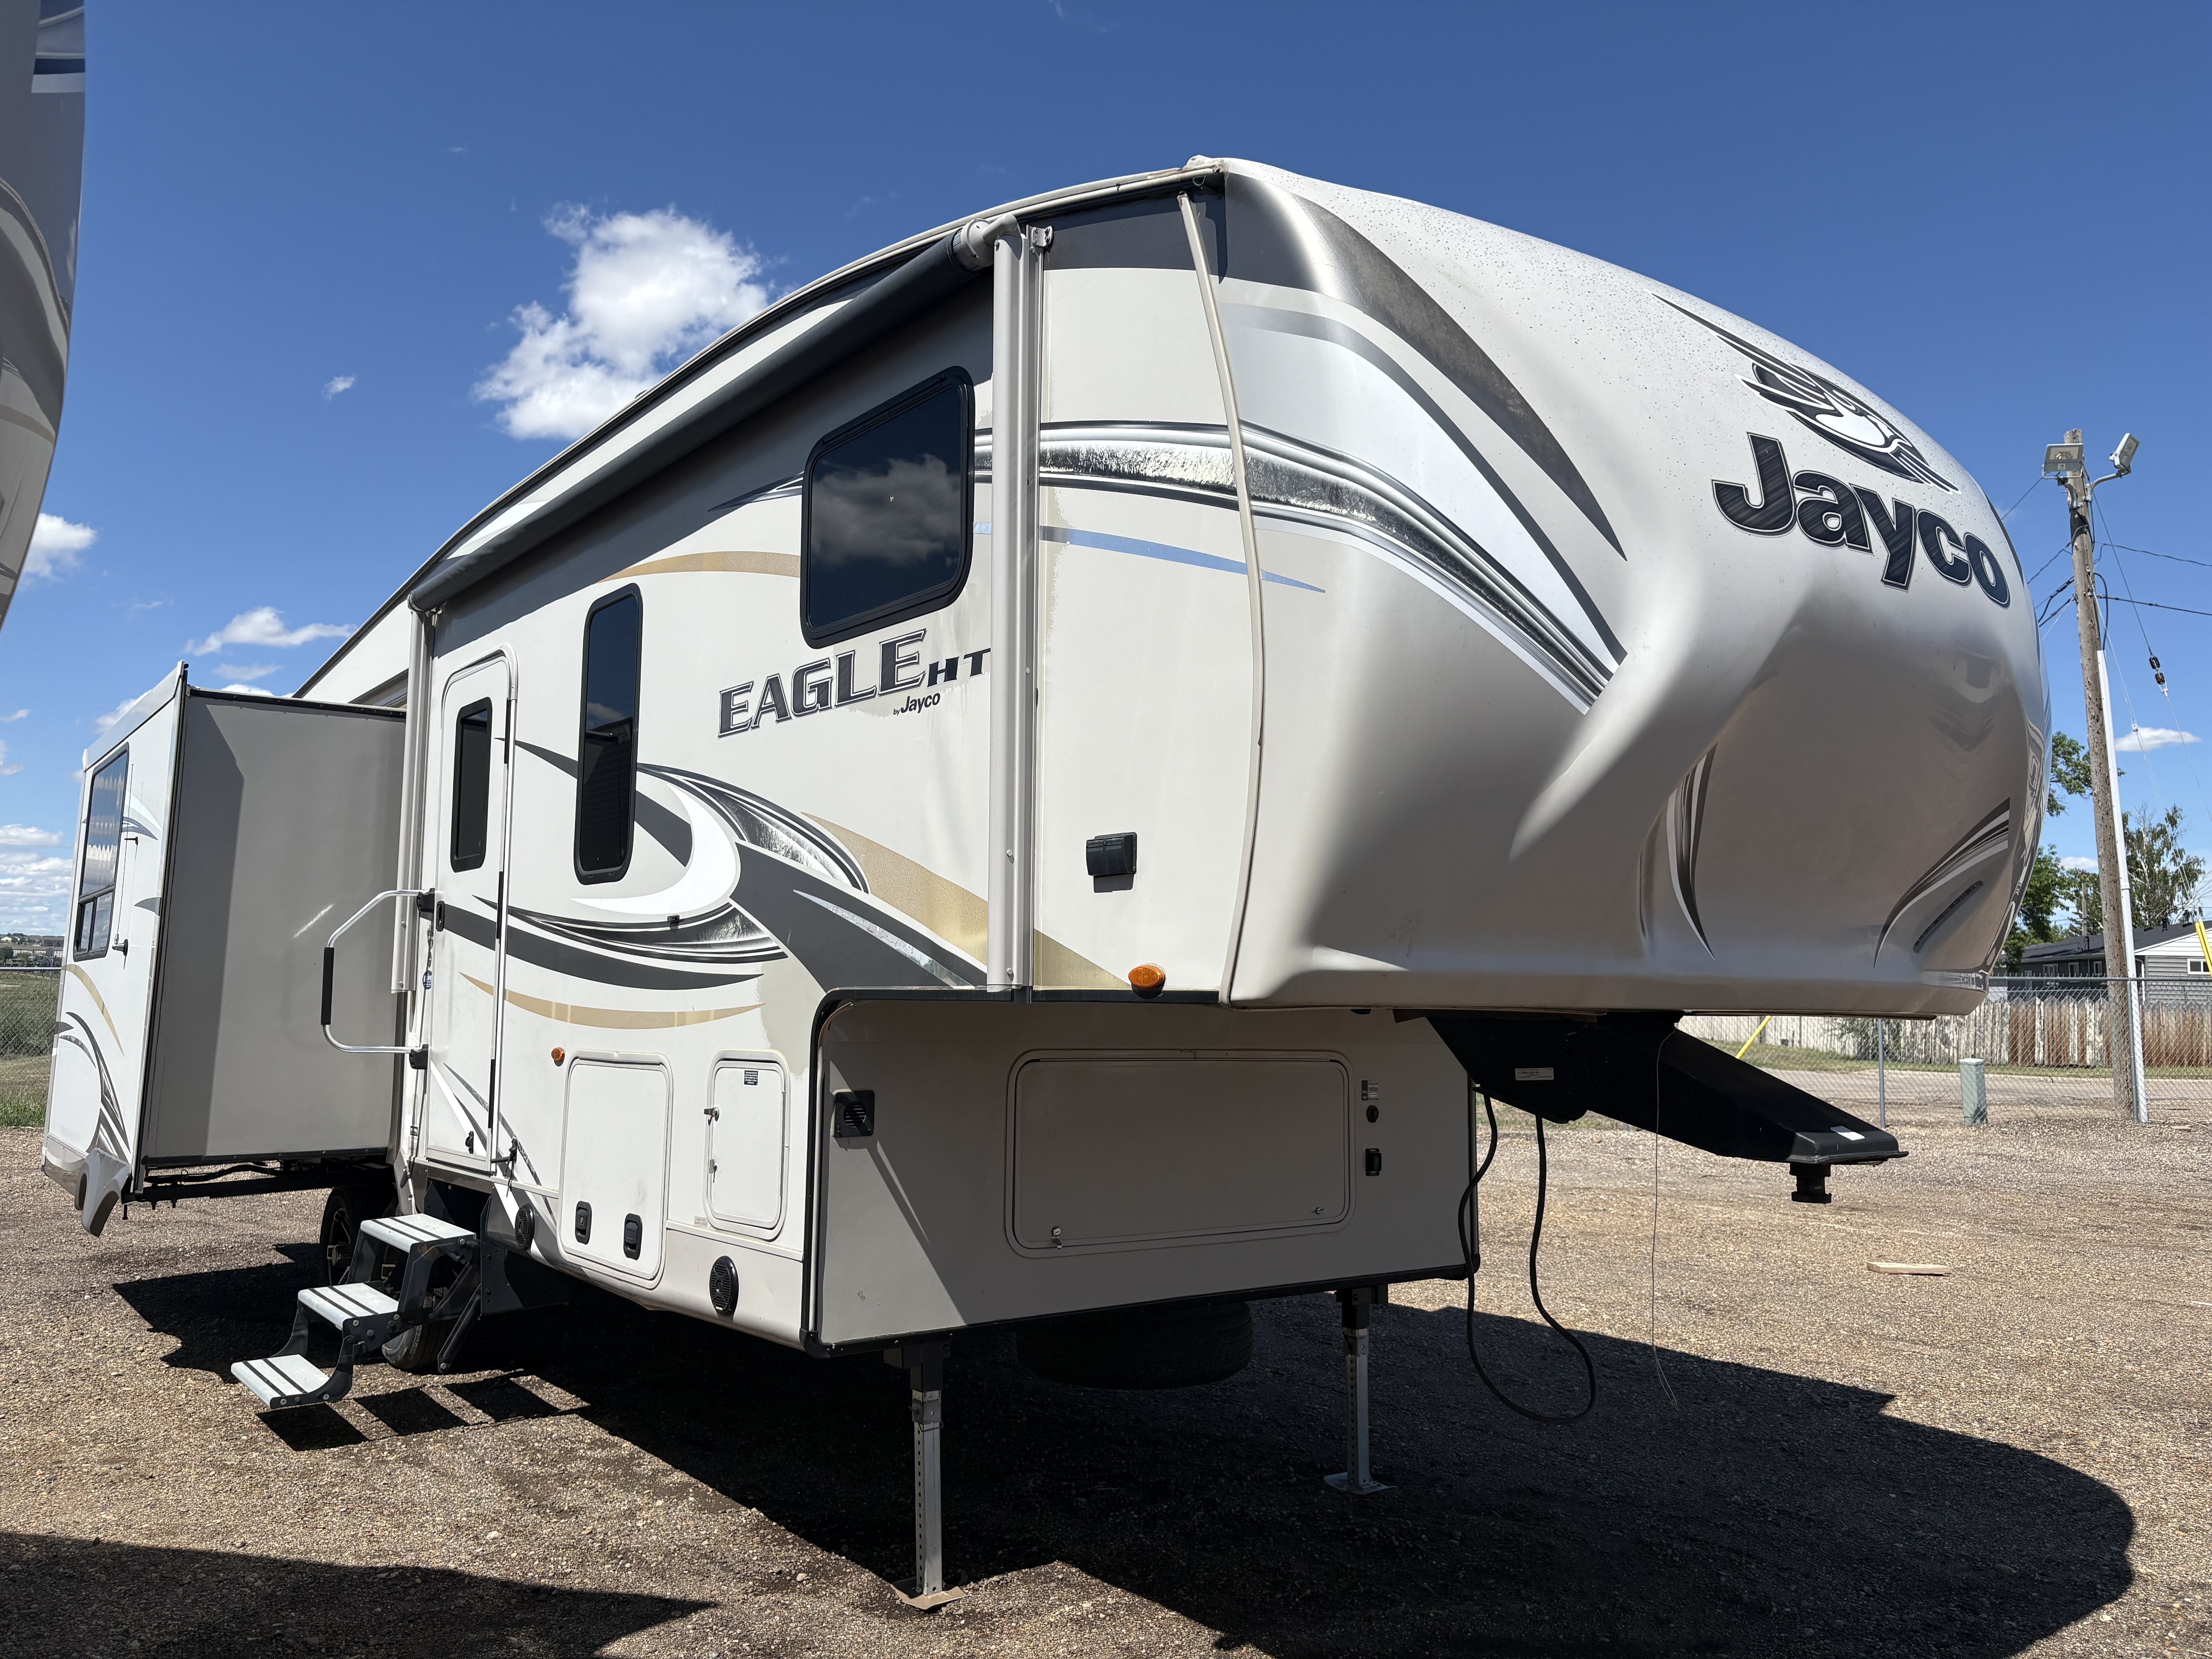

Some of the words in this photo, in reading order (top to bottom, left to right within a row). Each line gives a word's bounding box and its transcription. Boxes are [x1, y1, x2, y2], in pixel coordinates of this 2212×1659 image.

[1711, 432, 2010, 609] Jayco
[718, 628, 927, 739] EAGLE
[927, 647, 991, 687] HT
[900, 692, 941, 713] Jayco
